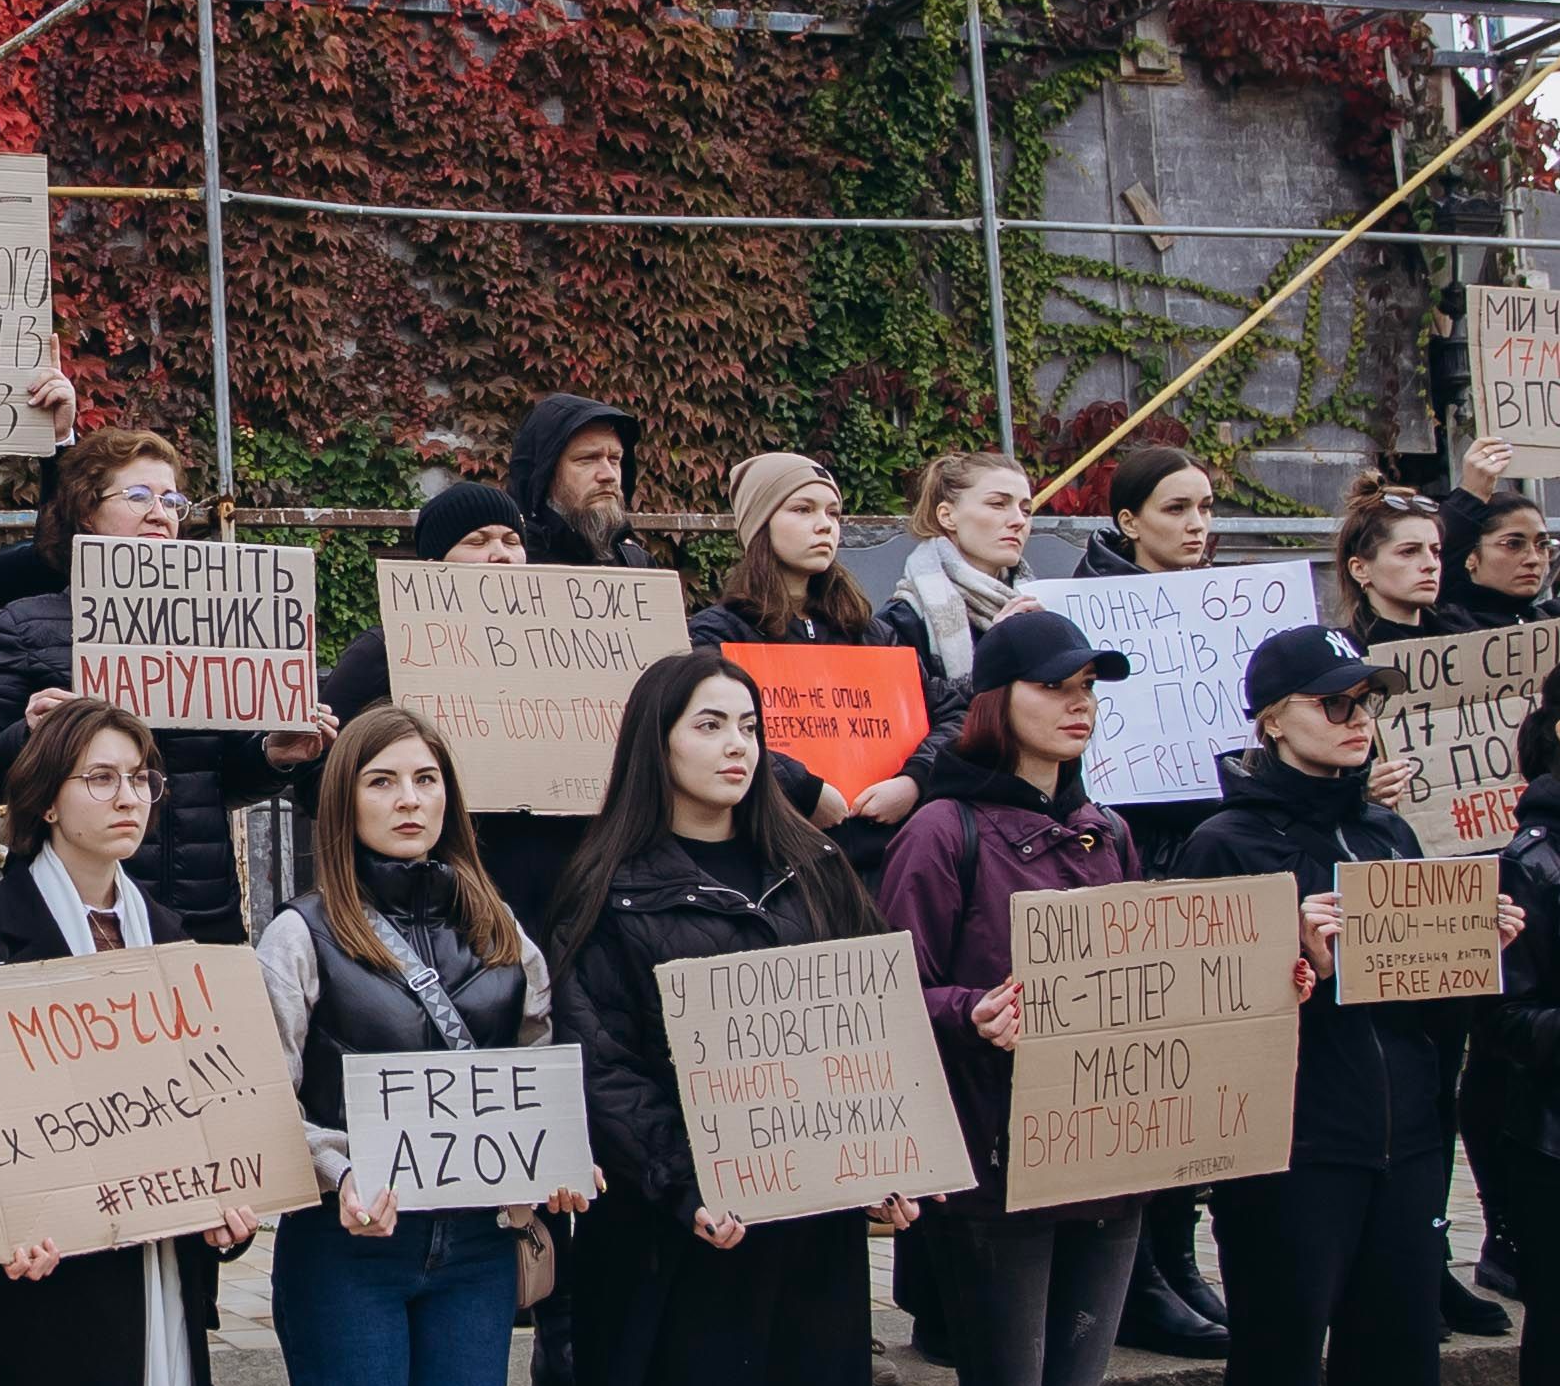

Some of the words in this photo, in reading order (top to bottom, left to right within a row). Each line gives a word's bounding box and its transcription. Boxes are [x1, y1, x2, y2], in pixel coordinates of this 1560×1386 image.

[1487, 295, 1536, 333] МІЙ
[1494, 337, 1534, 377] 17
[80, 542, 294, 593] ПОВЕРНІТЬ
[391, 567, 463, 612] МІЙ
[480, 574, 545, 617] СИН
[567, 578, 651, 621] ВЖЕ
[78, 595, 306, 650] ЗАХИСНИКІВ
[1065, 585, 1180, 632] ПОНАД
[1201, 578, 1285, 620] 650
[80, 614, 318, 723] МАРІУПОЛЯ!
[400, 624, 430, 667] 2
[425, 619, 479, 667] РІК
[486, 627, 516, 667] В
[525, 628, 647, 671] ПОЛОНІ
[498, 690, 564, 740] ЙОГО
[848, 718, 891, 738] ЖИТТЯ
[1391, 702, 1434, 753] 17
[1368, 863, 1482, 908] OLENIVKA
[1026, 904, 1092, 964] ВОНИ
[1102, 893, 1259, 958] ВРЯТУВАЛИ
[669, 972, 686, 1018] У
[711, 949, 900, 1010] ПОЛОНЕНИХ
[1201, 956, 1251, 1016] МИ
[1379, 970, 1429, 997] FREE
[1439, 968, 1489, 993] AZOV
[8, 963, 221, 1072] МОВЧИ!
[728, 994, 886, 1060] АЗОВСТАЛІ
[35, 1044, 257, 1154] ВБИВАЄ!!!
[378, 1065, 541, 1120] FREE
[689, 1061, 799, 1106] ГНИЮТЬ
[1072, 1039, 1191, 1105] МАЄМО
[701, 1114, 720, 1154] У
[749, 1095, 907, 1149] БАЙДУЖИХ
[1023, 1096, 1194, 1168] ВРЯТУВАТИ
[1217, 1085, 1249, 1138] ЇХ
[96, 1154, 263, 1215] #FREEAZOV
[390, 1129, 546, 1190] AZOV
[714, 1150, 801, 1198] ГНИЄ
